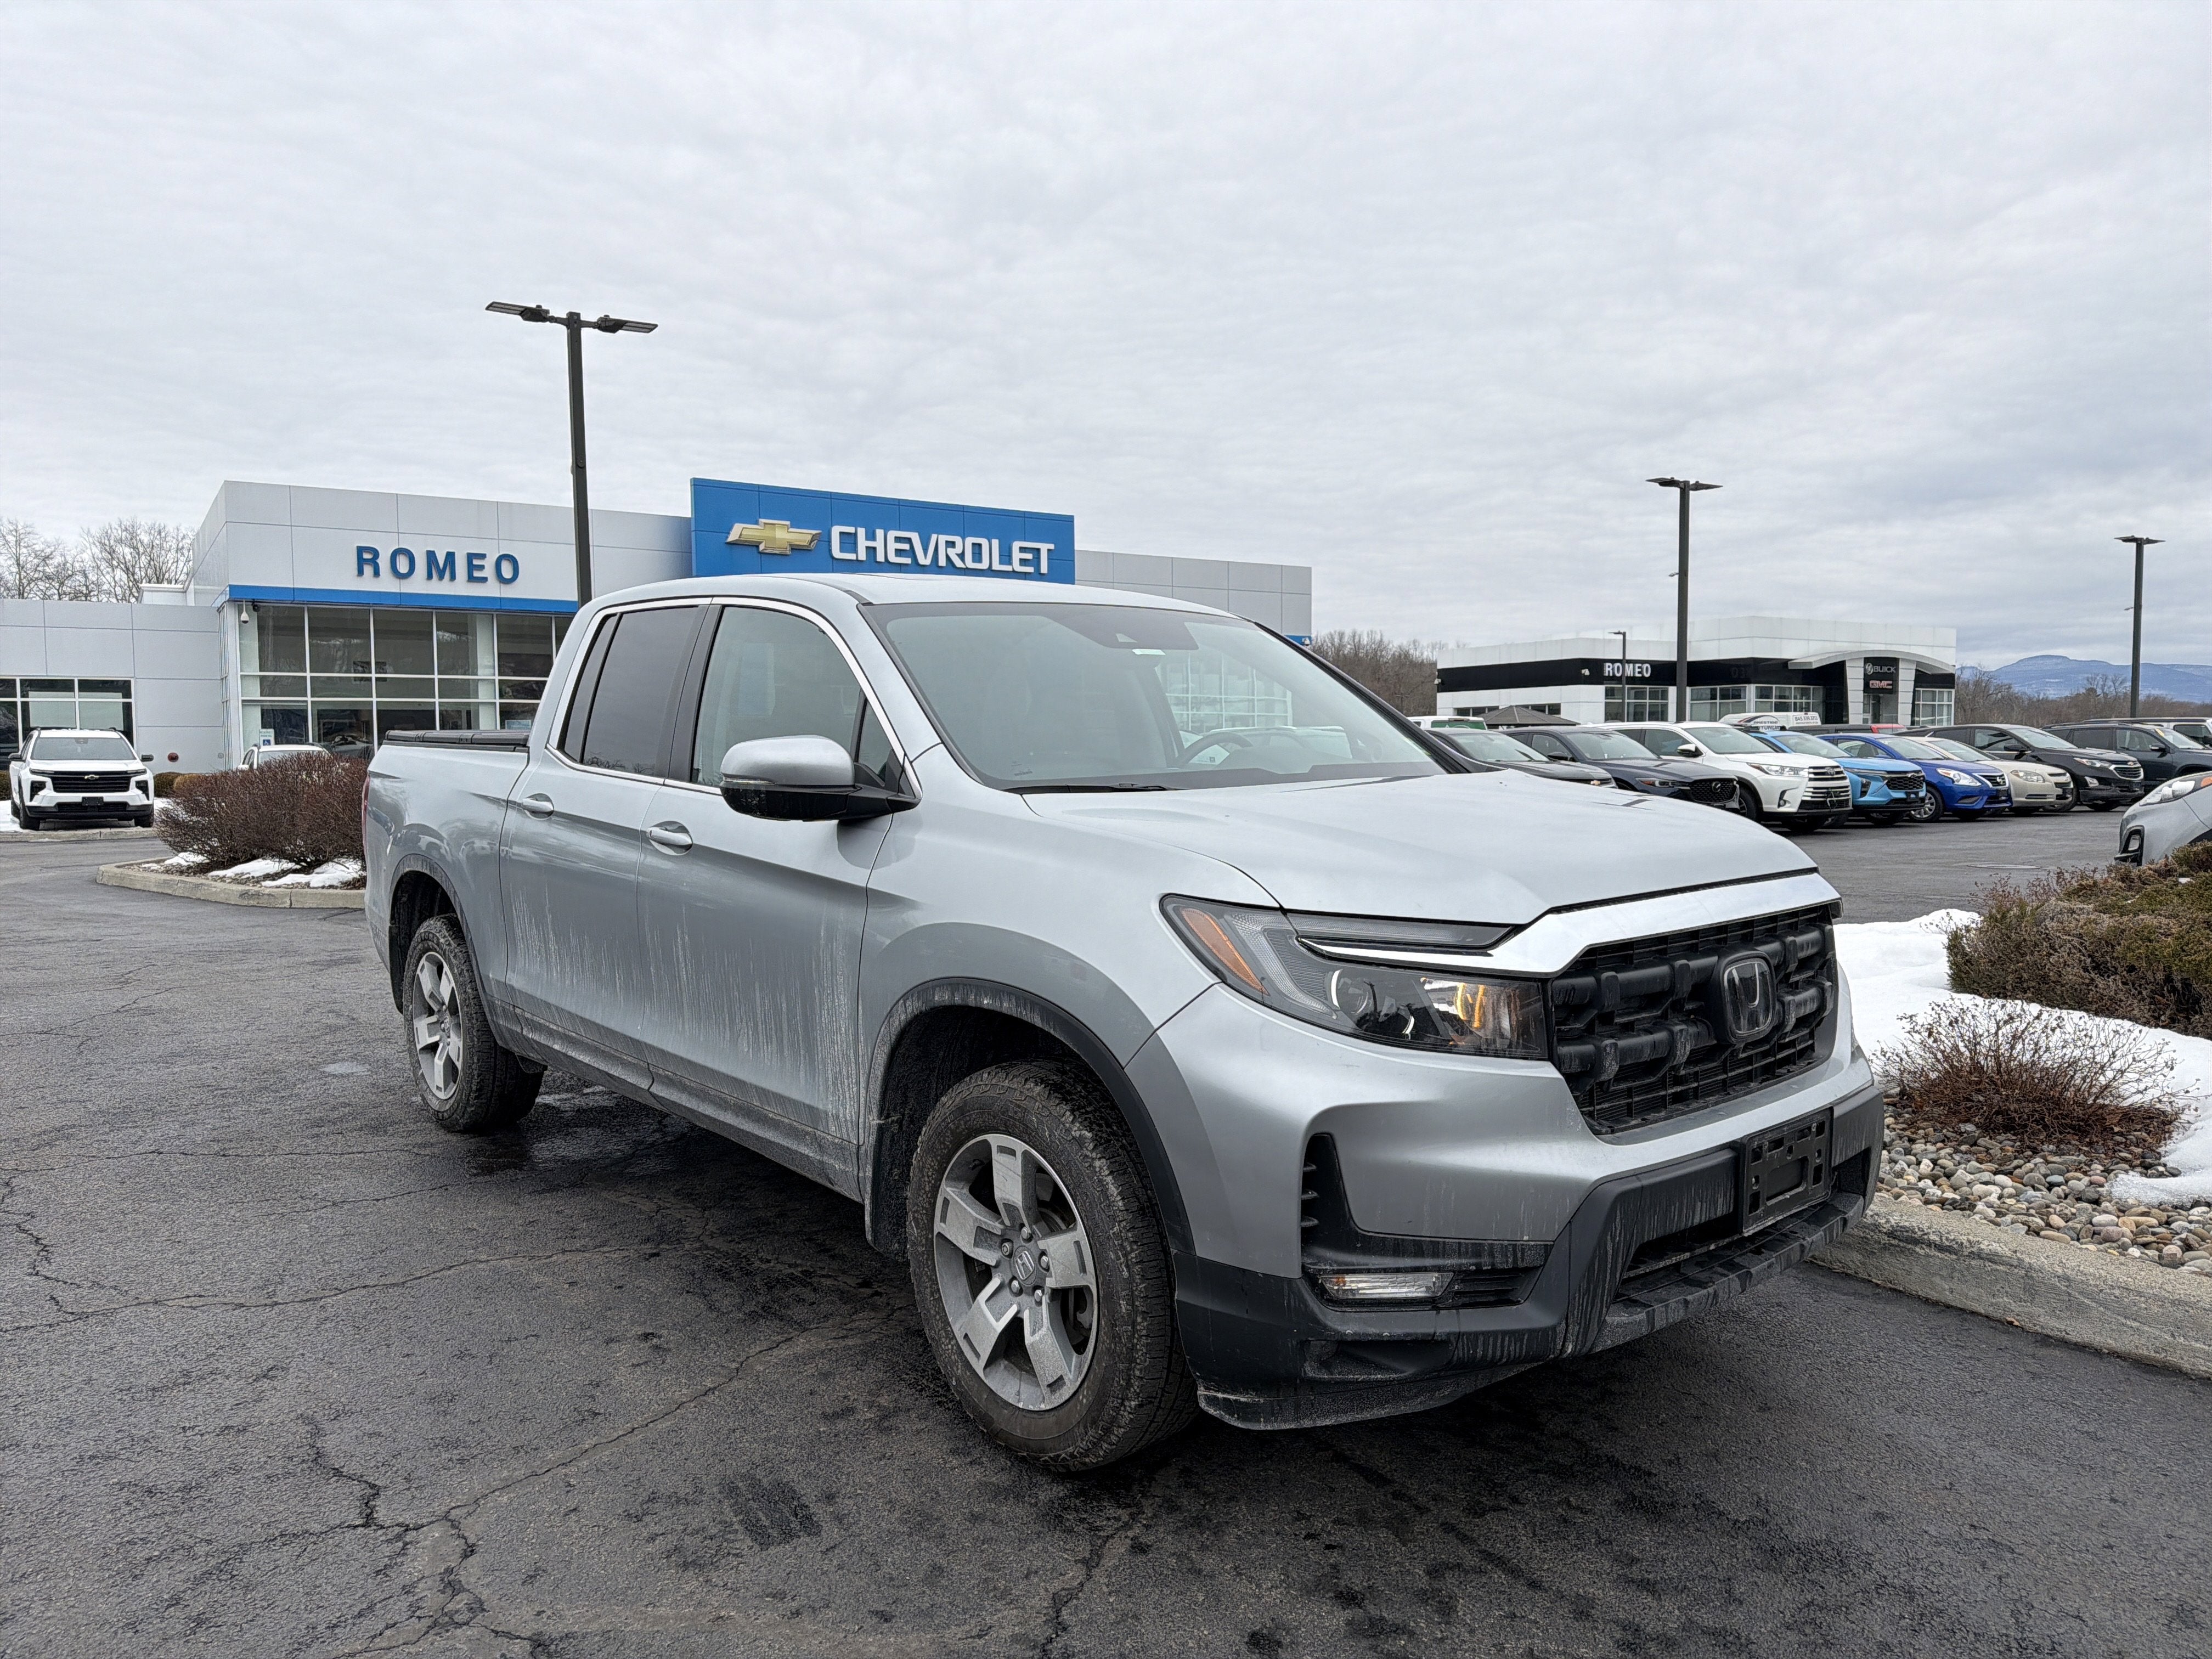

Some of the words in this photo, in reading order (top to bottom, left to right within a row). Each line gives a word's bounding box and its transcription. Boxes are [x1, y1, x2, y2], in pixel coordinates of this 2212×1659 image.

[831, 526, 1054, 574] CHEVROLET
[357, 545, 519, 584] ROMEO
[1604, 663, 1651, 677] ROMEO
[1869, 680, 1893, 689] GMC
